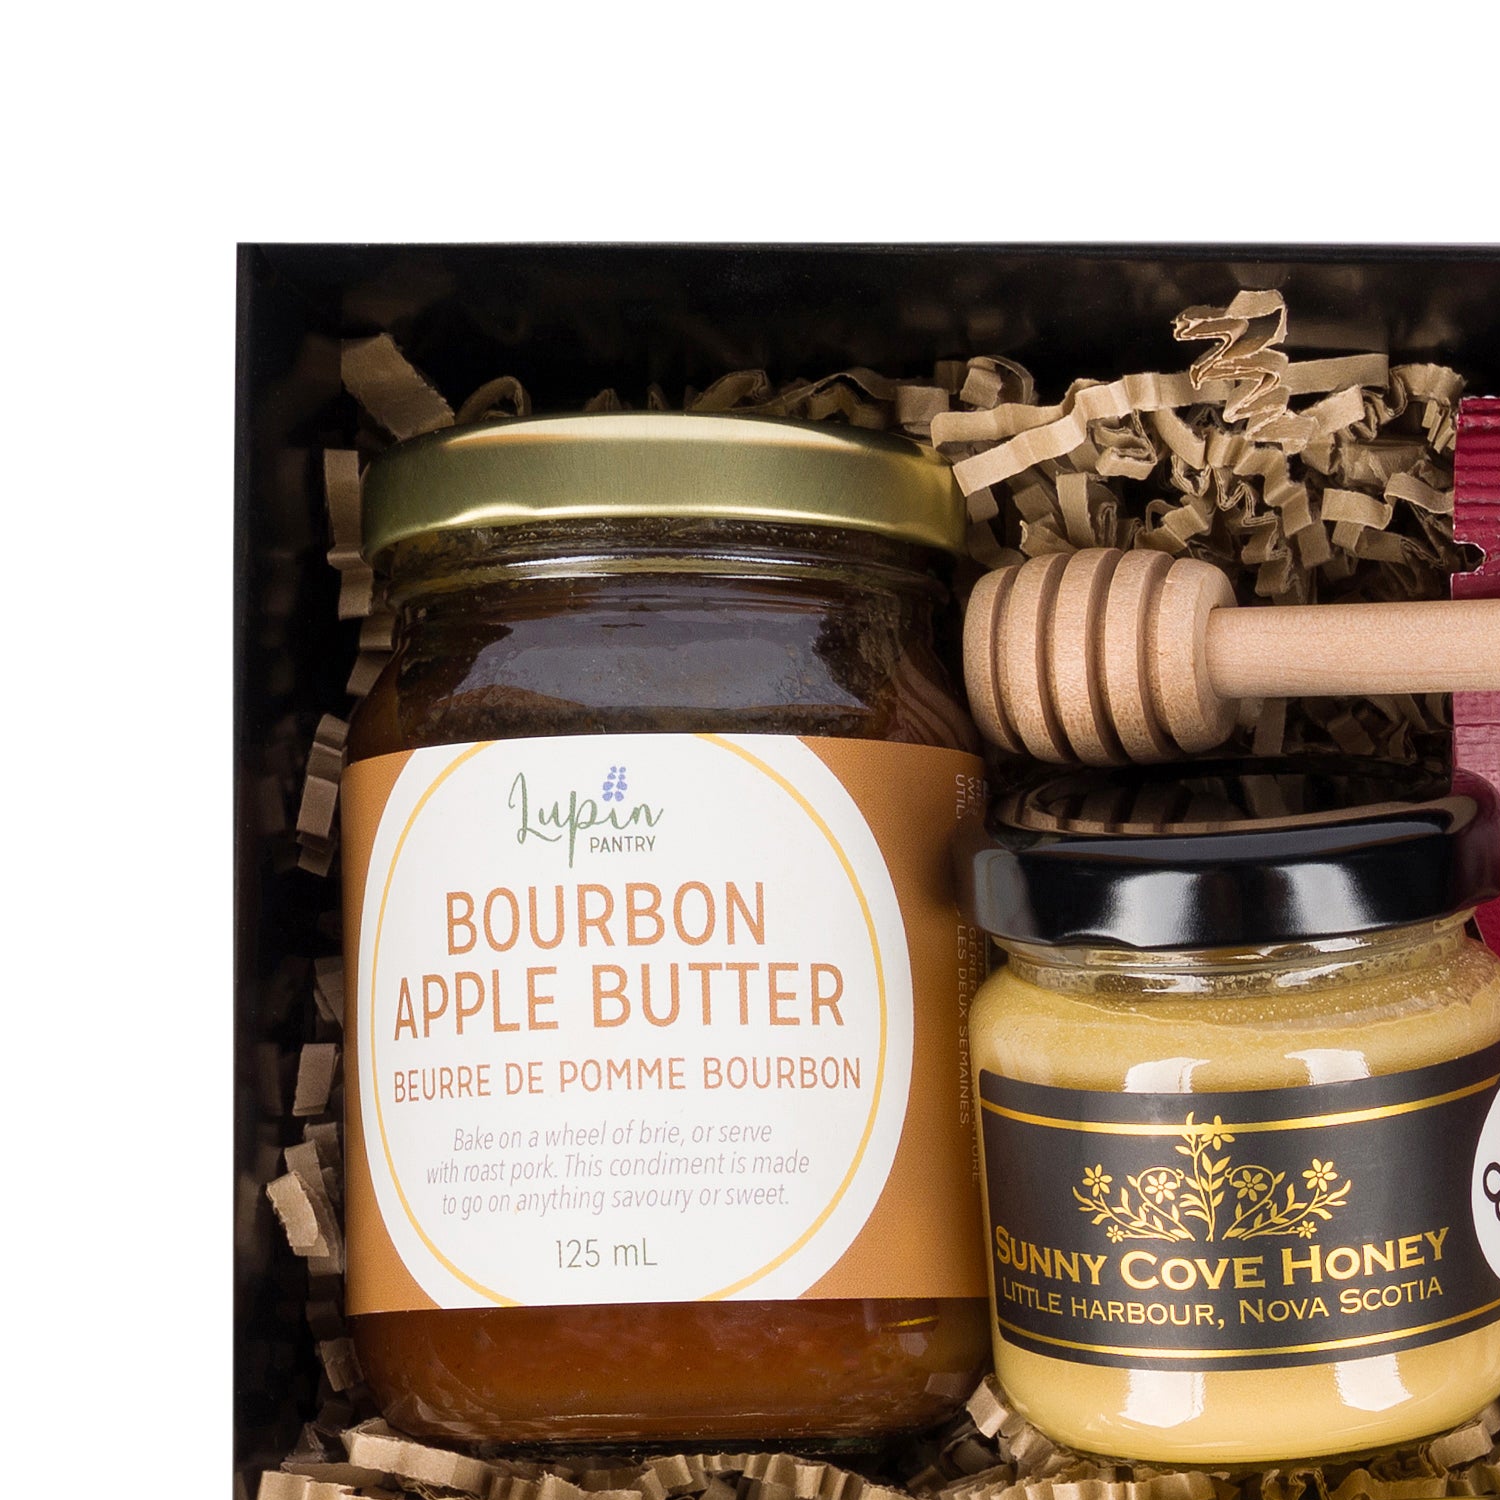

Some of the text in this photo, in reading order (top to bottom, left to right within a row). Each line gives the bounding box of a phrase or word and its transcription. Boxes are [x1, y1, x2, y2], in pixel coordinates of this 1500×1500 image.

[508, 772, 664, 868] Lupin
[590, 836, 655, 853] PANTRY
[446, 881, 765, 956] BOURBON
[957, 925, 967, 960] LES
[394, 962, 844, 1041] APPLE BUTTER
[958, 967, 968, 1018] DEUX
[394, 1057, 860, 1103] BEURRE DE POMME BOURBON
[959, 1025, 970, 1128] SEMAINES.
[454, 1119, 772, 1151] Bake on a wheel of brie, or serve
[427, 1149, 809, 1187] with roast pork. This condiment is made
[443, 1184, 789, 1221] to go on anything savoury or sweet.
[556, 1238, 657, 1268] 125 mL
